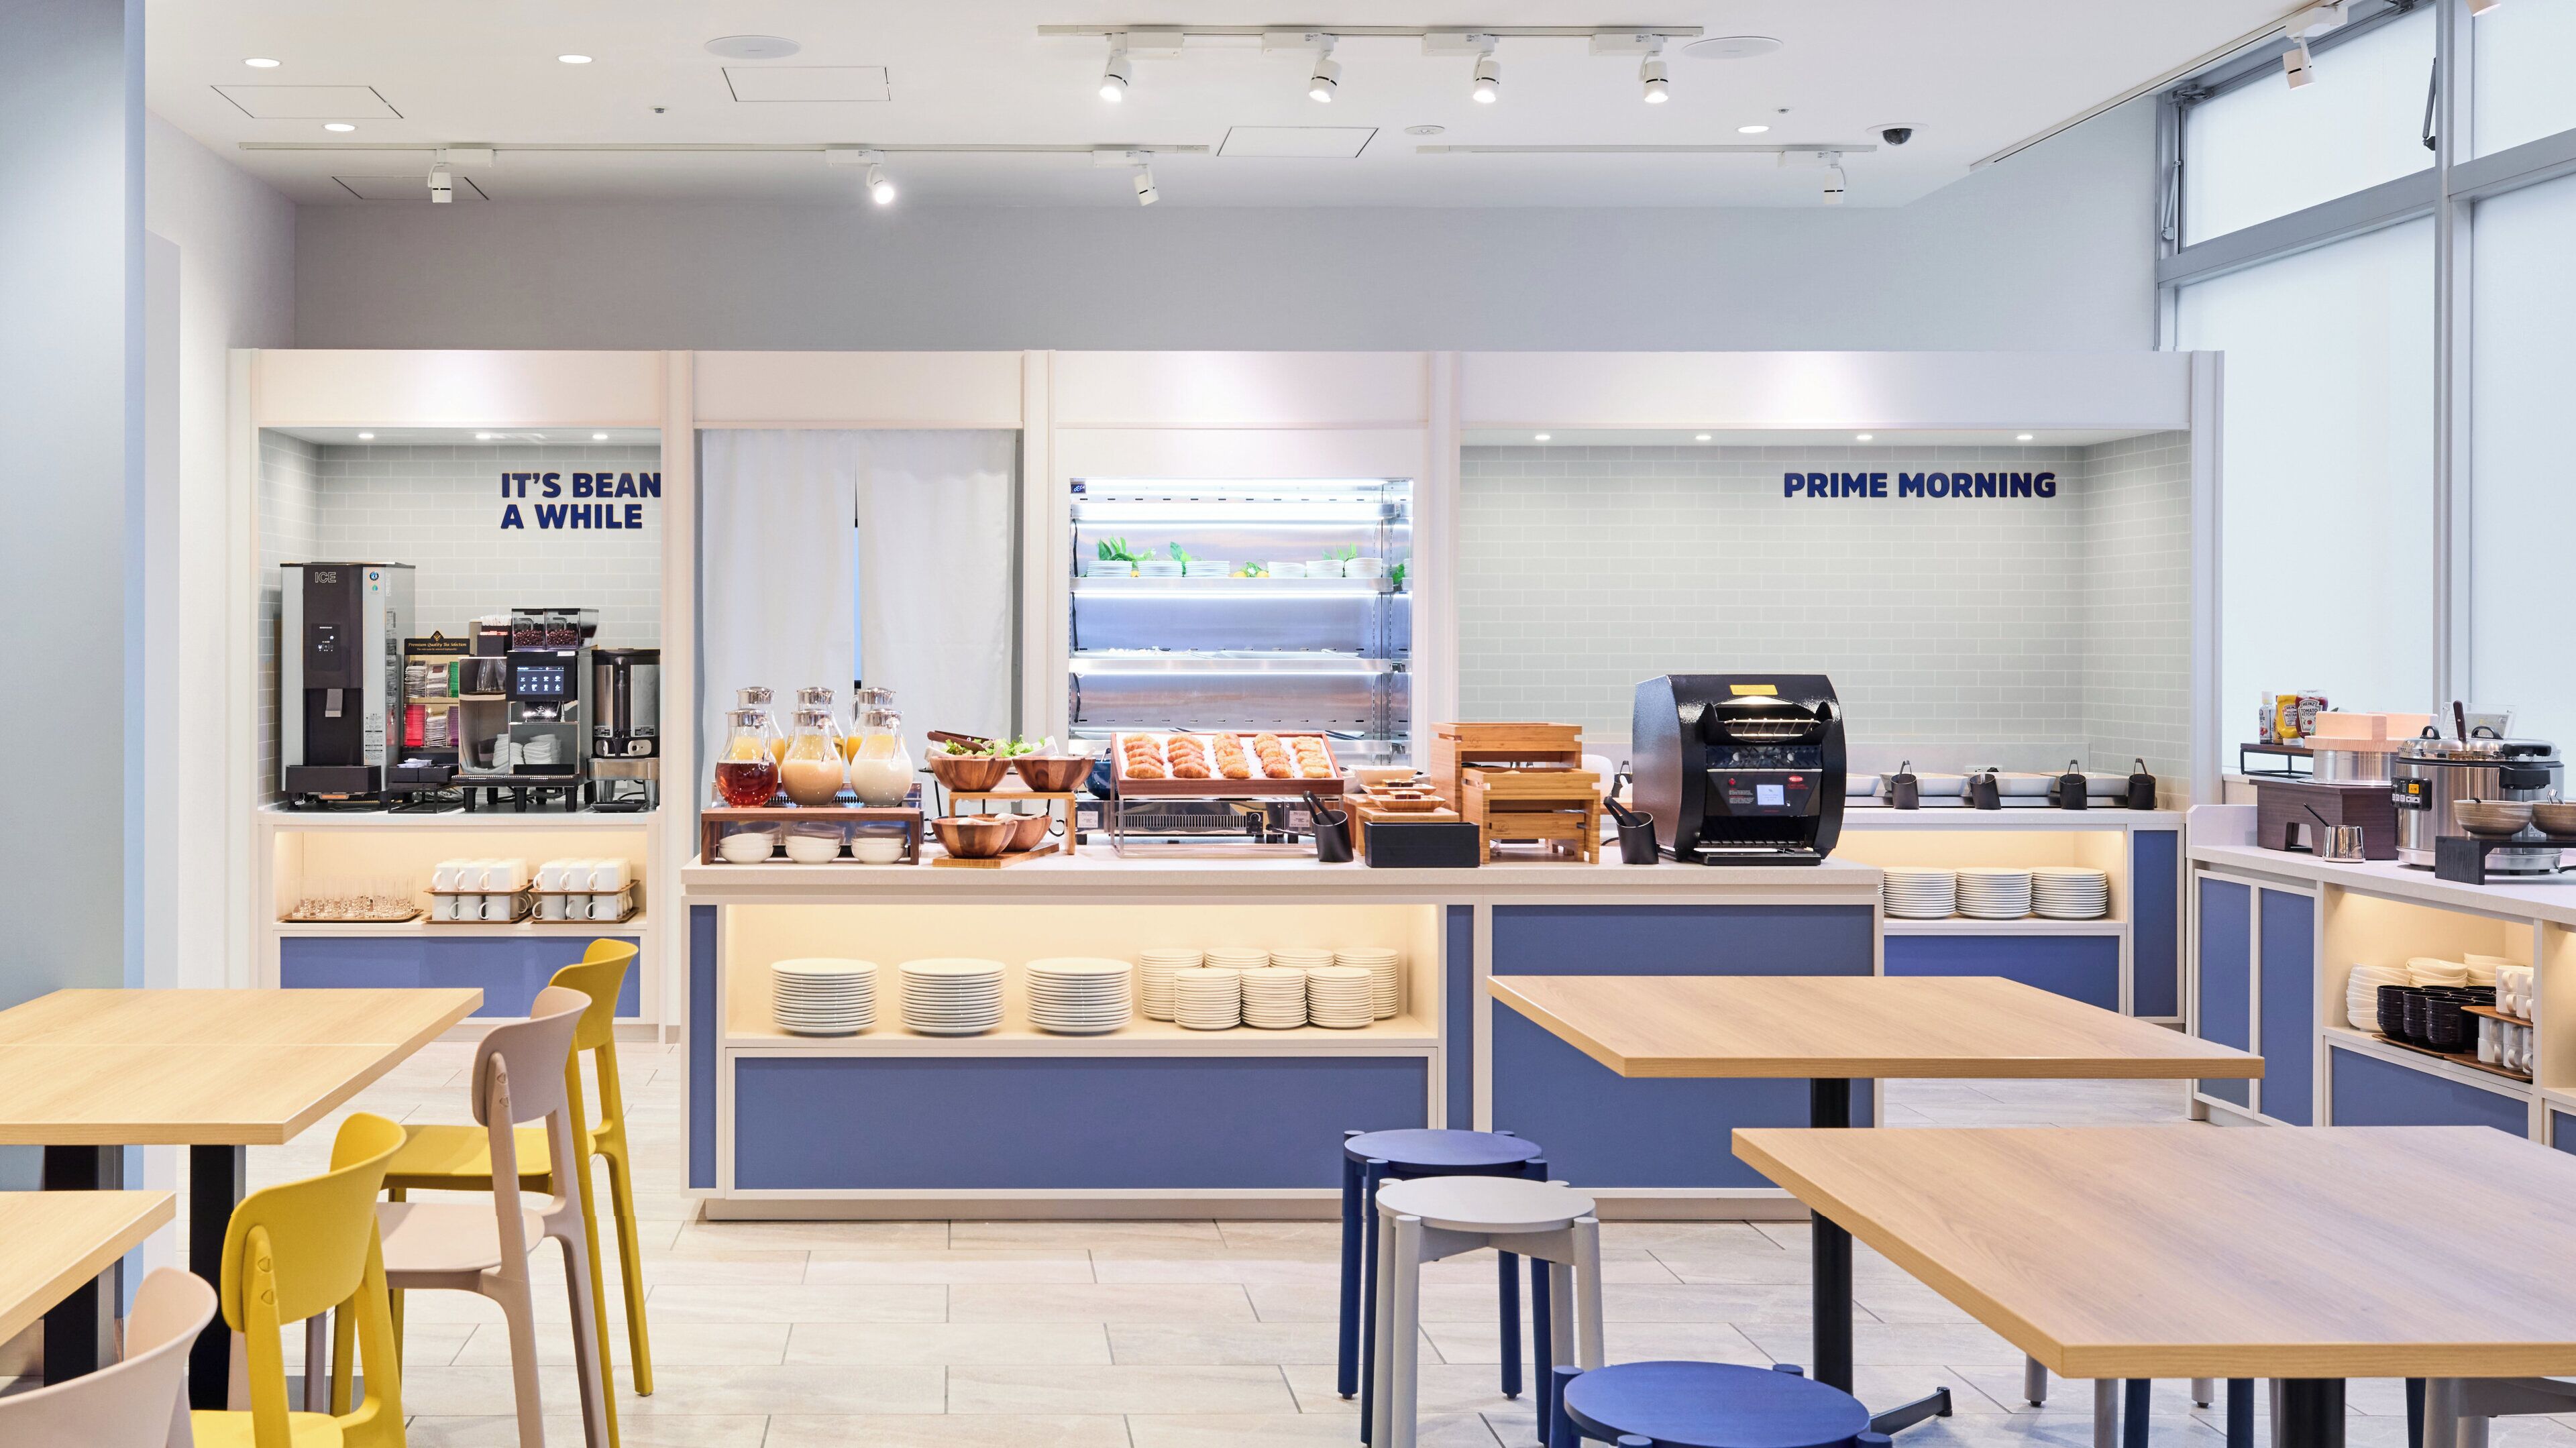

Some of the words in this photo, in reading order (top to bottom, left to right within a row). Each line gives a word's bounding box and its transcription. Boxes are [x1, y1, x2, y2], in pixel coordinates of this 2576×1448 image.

[502, 472, 561, 498] IT'S
[573, 472, 661, 498] BEAN
[1784, 472, 1888, 498] PRIME
[1898, 472, 2057, 498] MORNING
[500, 504, 525, 529] A
[534, 504, 643, 529] WHILE
[315, 571, 337, 583] ICE
